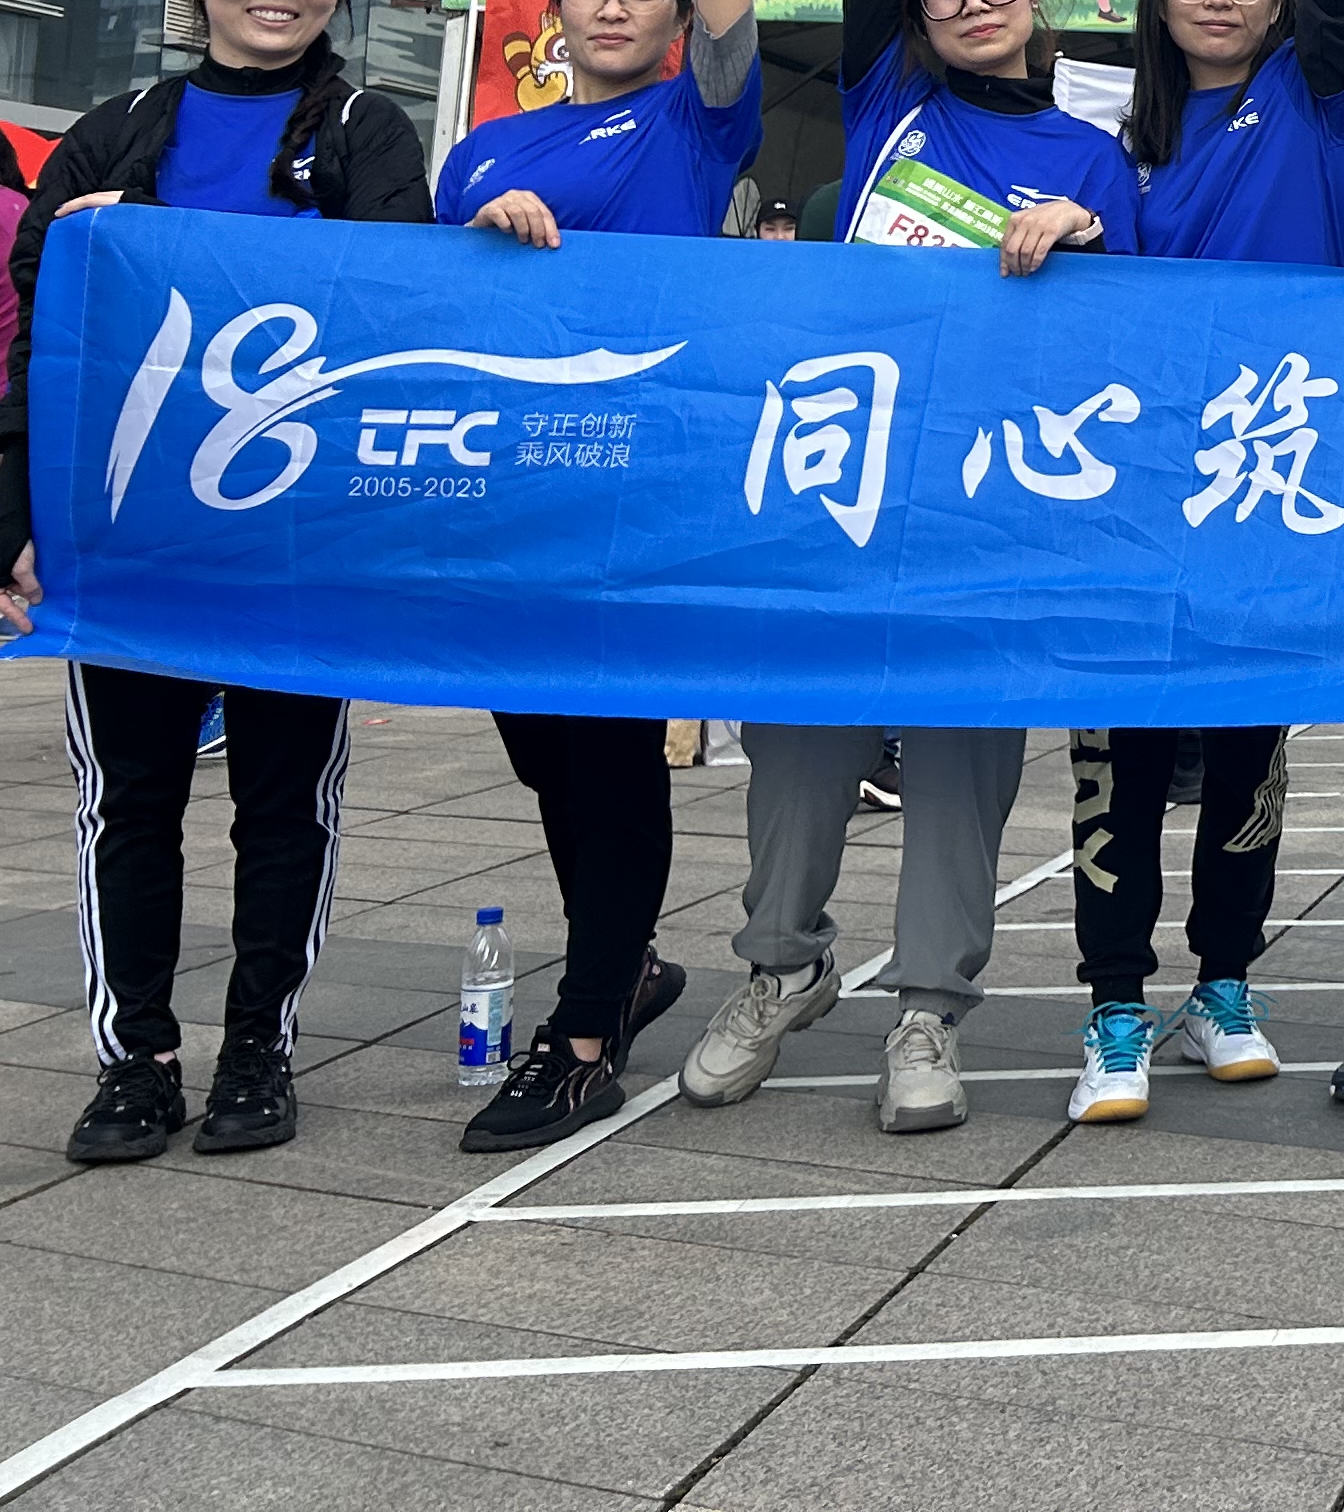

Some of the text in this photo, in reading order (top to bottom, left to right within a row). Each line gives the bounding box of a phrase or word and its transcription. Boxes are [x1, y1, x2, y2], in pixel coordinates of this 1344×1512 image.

[578, 118, 637, 145] RKE
[1007, 193, 1037, 209] ER
[521, 411, 637, 439] 守正创新
[514, 441, 631, 468] 乘风破浪
[348, 475, 487, 499] 2005-2023
